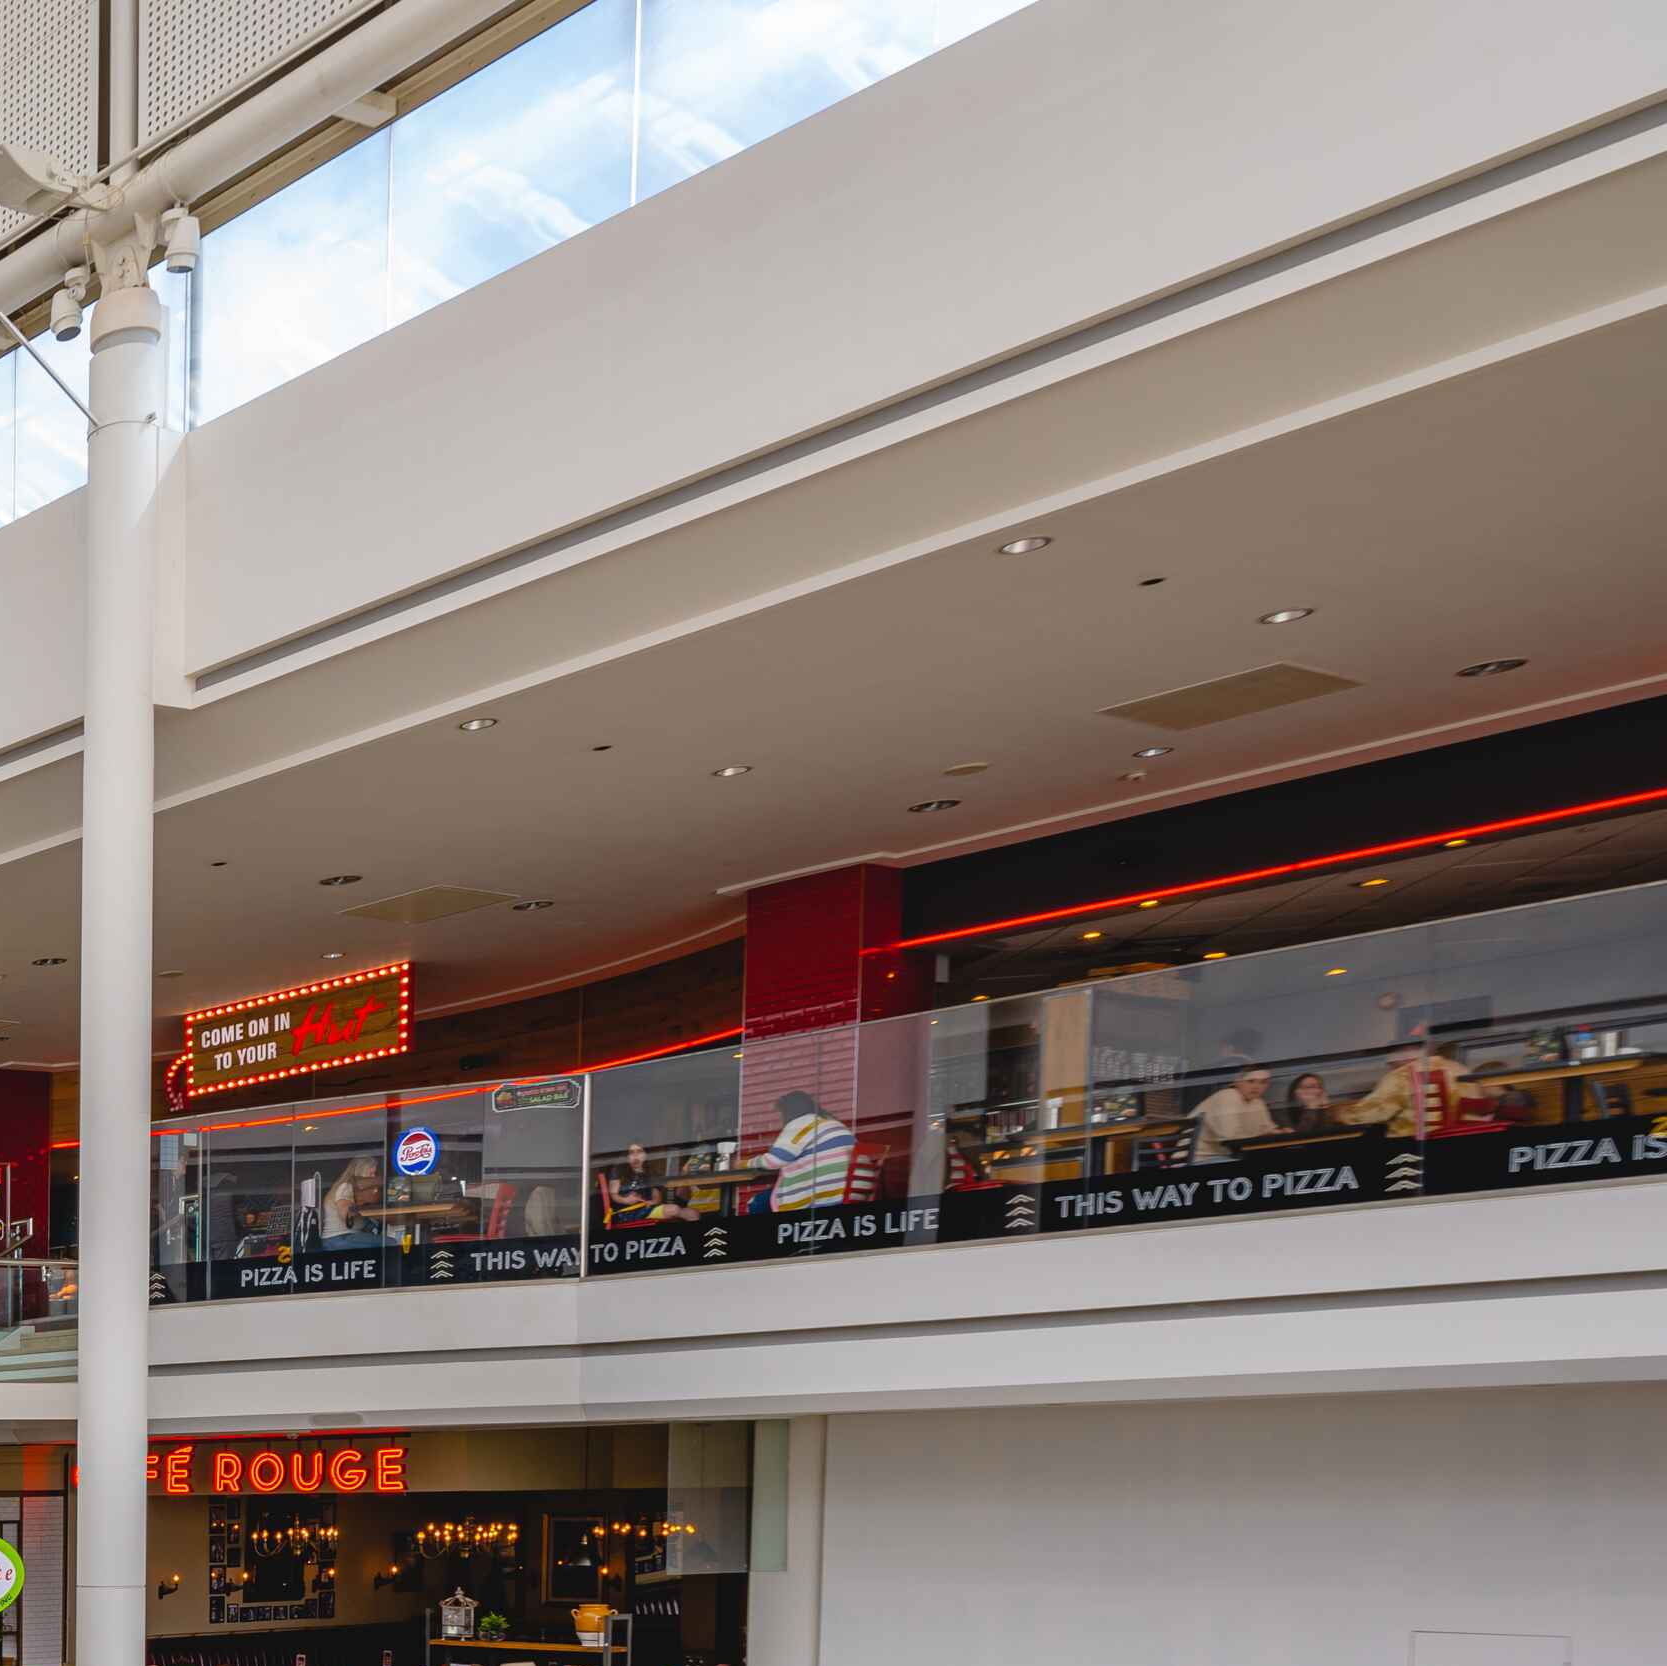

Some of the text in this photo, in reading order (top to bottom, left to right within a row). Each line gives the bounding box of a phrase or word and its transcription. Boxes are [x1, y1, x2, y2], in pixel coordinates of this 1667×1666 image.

[201, 1012, 291, 1048] COME ON IN
[291, 994, 386, 1056] Hut
[214, 1042, 277, 1071] TO YOUR
[1132, 1181, 1201, 1211] WAY
[1206, 1176, 1253, 1203] TO
[533, 1248, 581, 1270] WAY
[590, 1243, 619, 1262] TO
[215, 1448, 407, 1493] ROUGE
